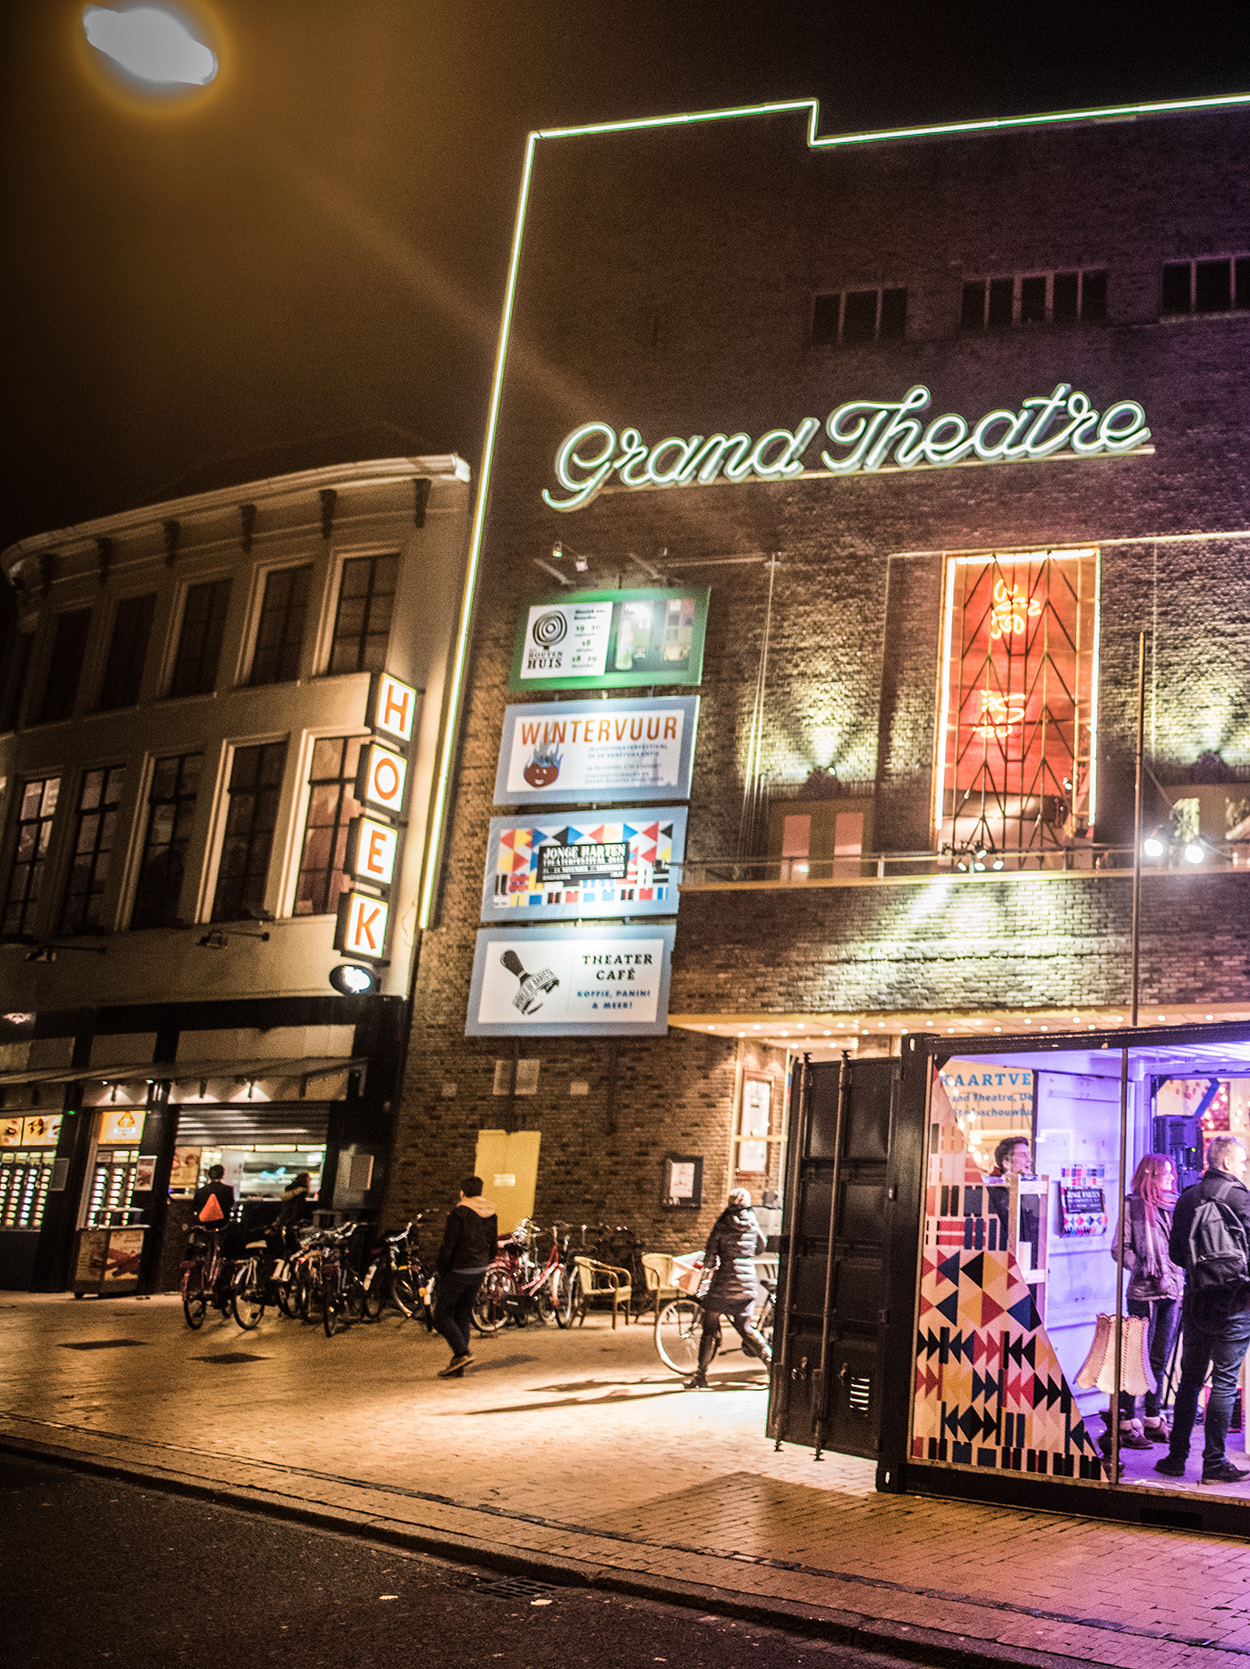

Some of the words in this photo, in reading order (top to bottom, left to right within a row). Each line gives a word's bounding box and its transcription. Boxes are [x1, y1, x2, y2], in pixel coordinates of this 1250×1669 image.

[542, 416, 821, 512] Grand
[821, 383, 1152, 476] Theatre
[527, 659, 561, 669] HUIS
[521, 716, 678, 745] WINTERVUUR
[353, 683, 409, 950] HOEK
[543, 847, 579, 859] JONGE
[581, 844, 625, 857] HARTEN
[582, 953, 653, 965] THEATER
[596, 966, 635, 981] CAFÉ
[973, 1093, 1016, 1102] Theatre,
